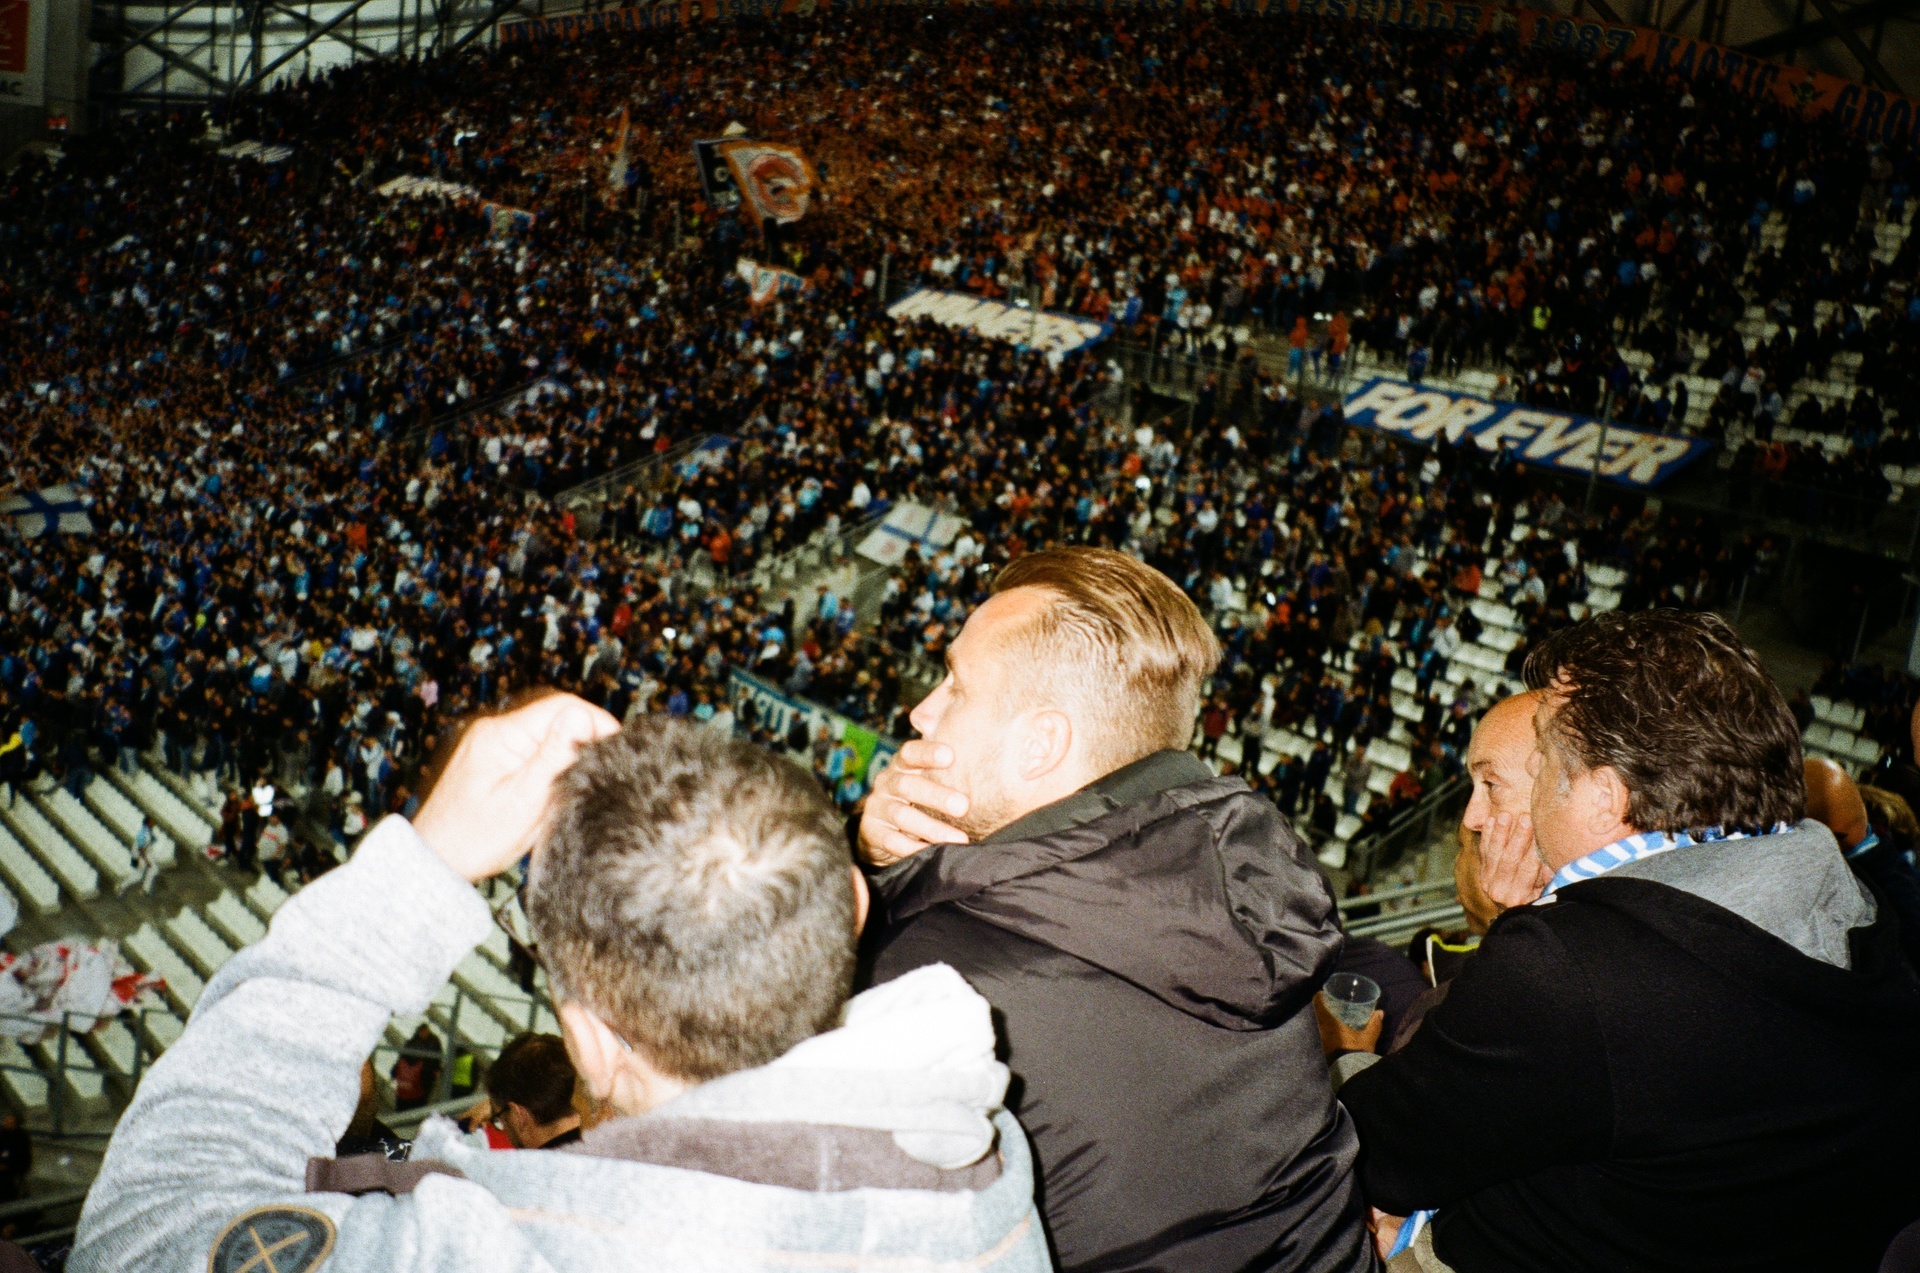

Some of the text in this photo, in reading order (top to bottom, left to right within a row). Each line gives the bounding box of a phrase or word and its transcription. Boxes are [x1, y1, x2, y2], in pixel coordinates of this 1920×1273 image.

[1531, 15, 1636, 58] 1987
[1653, 35, 1780, 103] KAOTIC
[1344, 381, 1691, 485] FOR EVER
